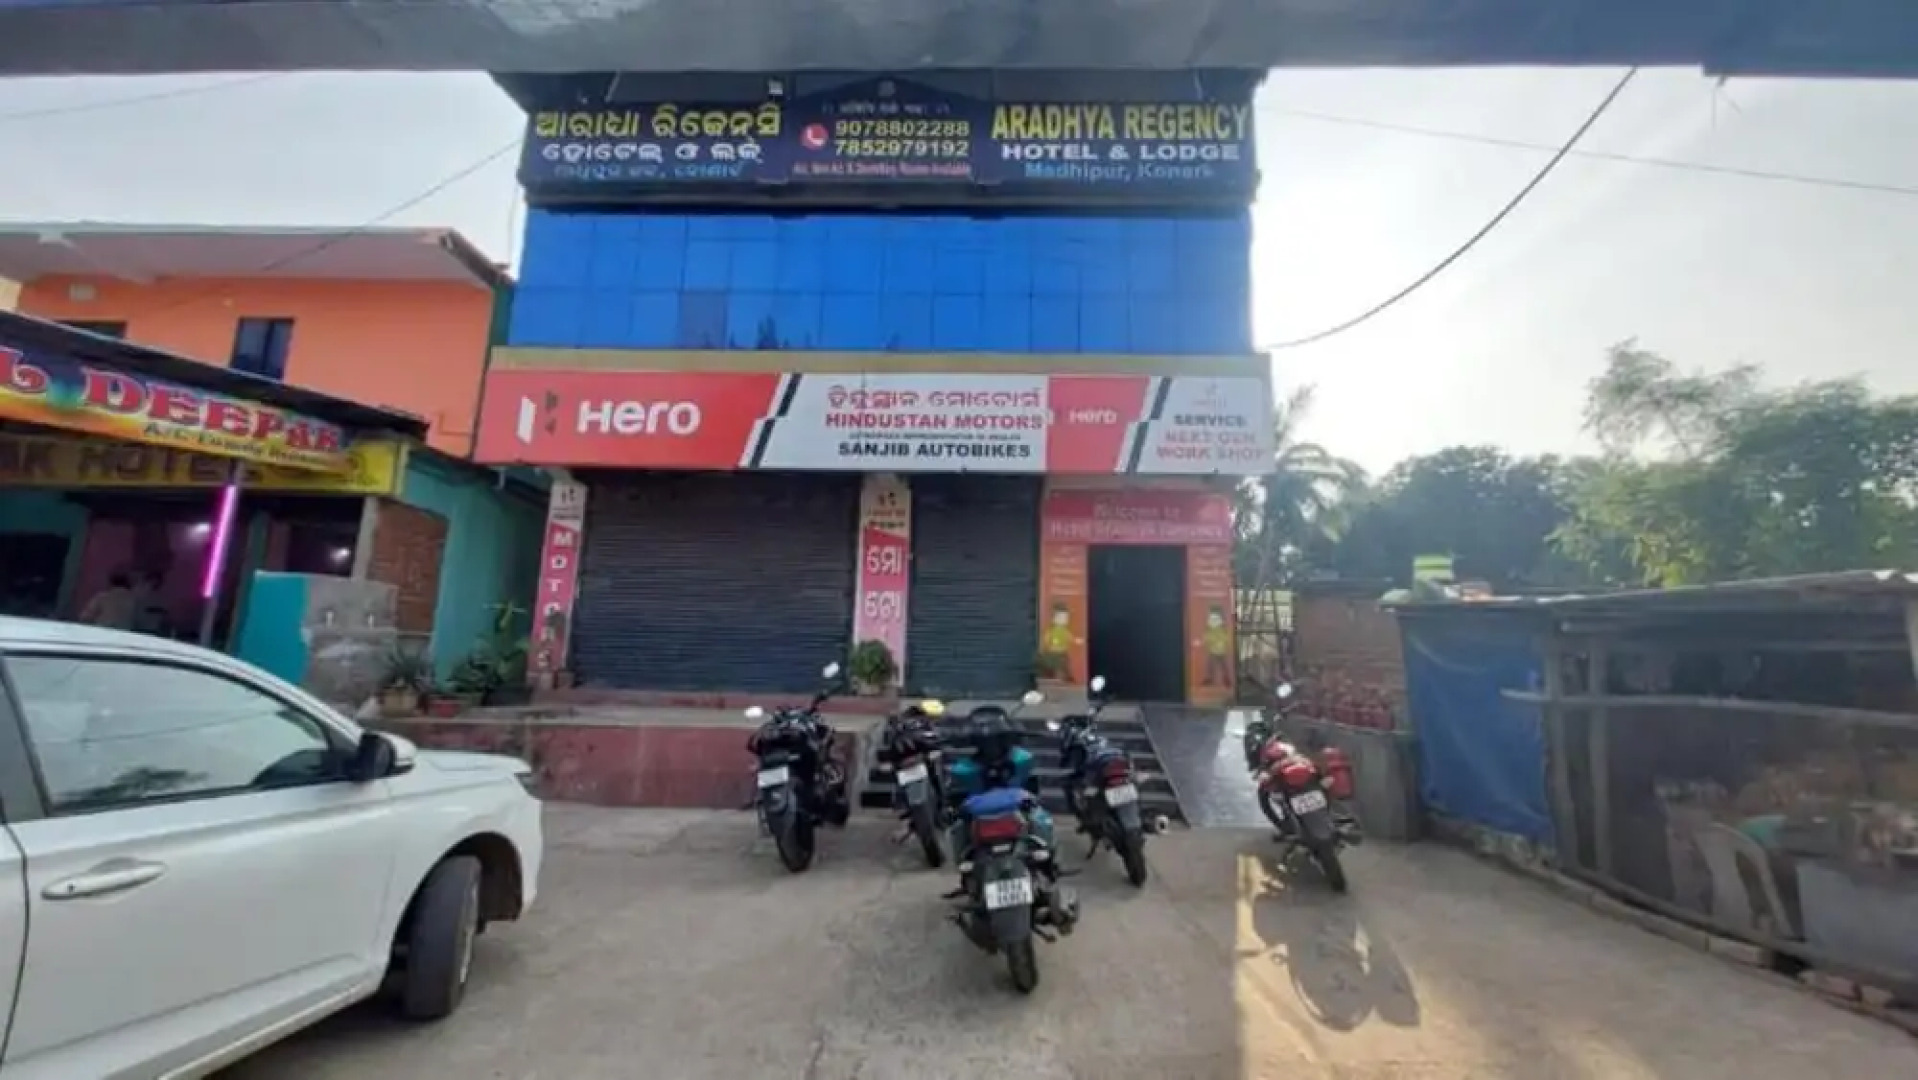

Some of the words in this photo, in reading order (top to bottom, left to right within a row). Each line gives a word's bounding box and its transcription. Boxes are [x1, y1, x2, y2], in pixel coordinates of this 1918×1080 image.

[835, 121, 970, 137] 9078802288
[991, 105, 1115, 139] ARADHYA
[1123, 105, 1247, 140] REGENCY
[835, 140, 969, 156] 7852979192
[1002, 144, 1098, 160] HOTEL
[1108, 144, 1129, 160] &
[1140, 144, 1240, 161] LODGE
[1025, 162, 1132, 181] Madhipur,
[80, 366, 343, 452] DEEPAK
[826, 413, 947, 428] HINDUSTAN
[954, 414, 1043, 430] MOTORS
[1174, 414, 1247, 427] SERVICE
[838, 442, 910, 457] SANJIB
[917, 442, 1031, 458] AUTOBIKES
